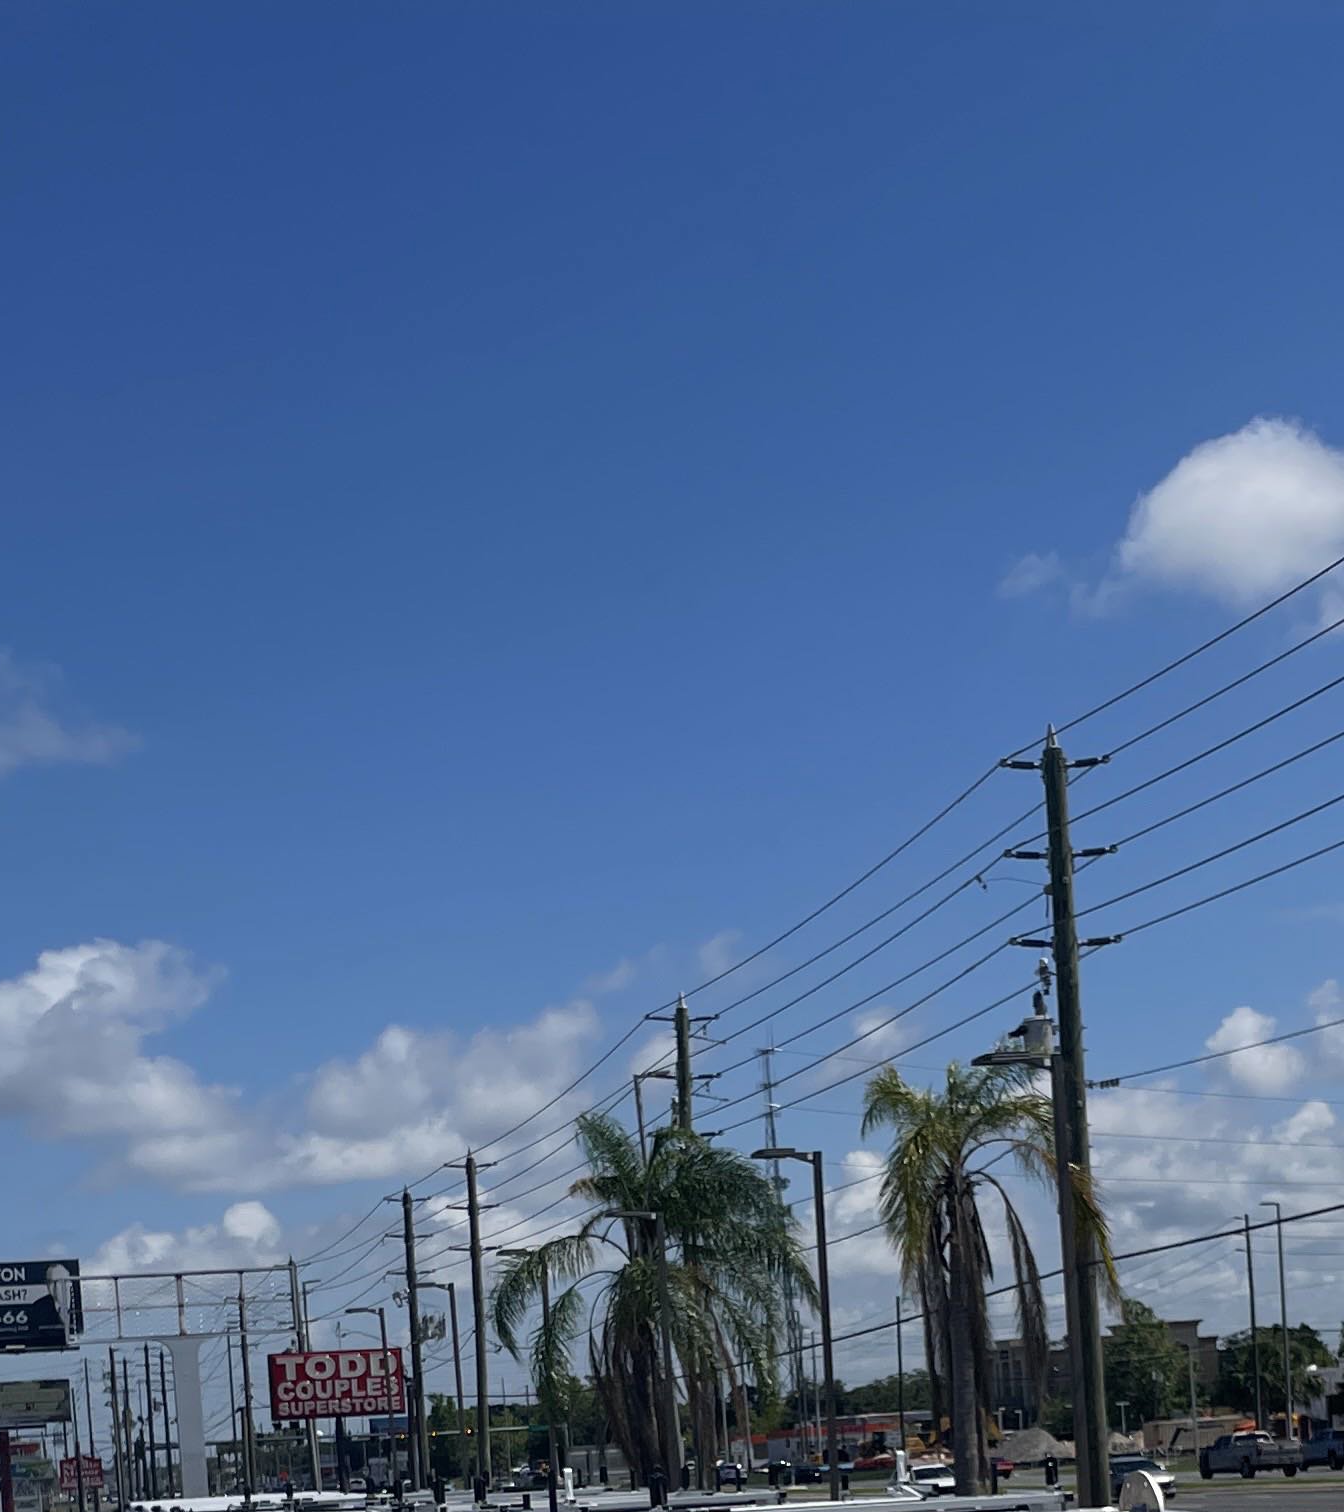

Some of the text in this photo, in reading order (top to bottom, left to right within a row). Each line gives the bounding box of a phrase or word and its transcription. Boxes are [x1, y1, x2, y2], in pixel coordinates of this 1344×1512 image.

[275, 1351, 398, 1381] TODD
[277, 1377, 400, 1401] COUPLES
[278, 1396, 401, 1416] SUPERSTORE
